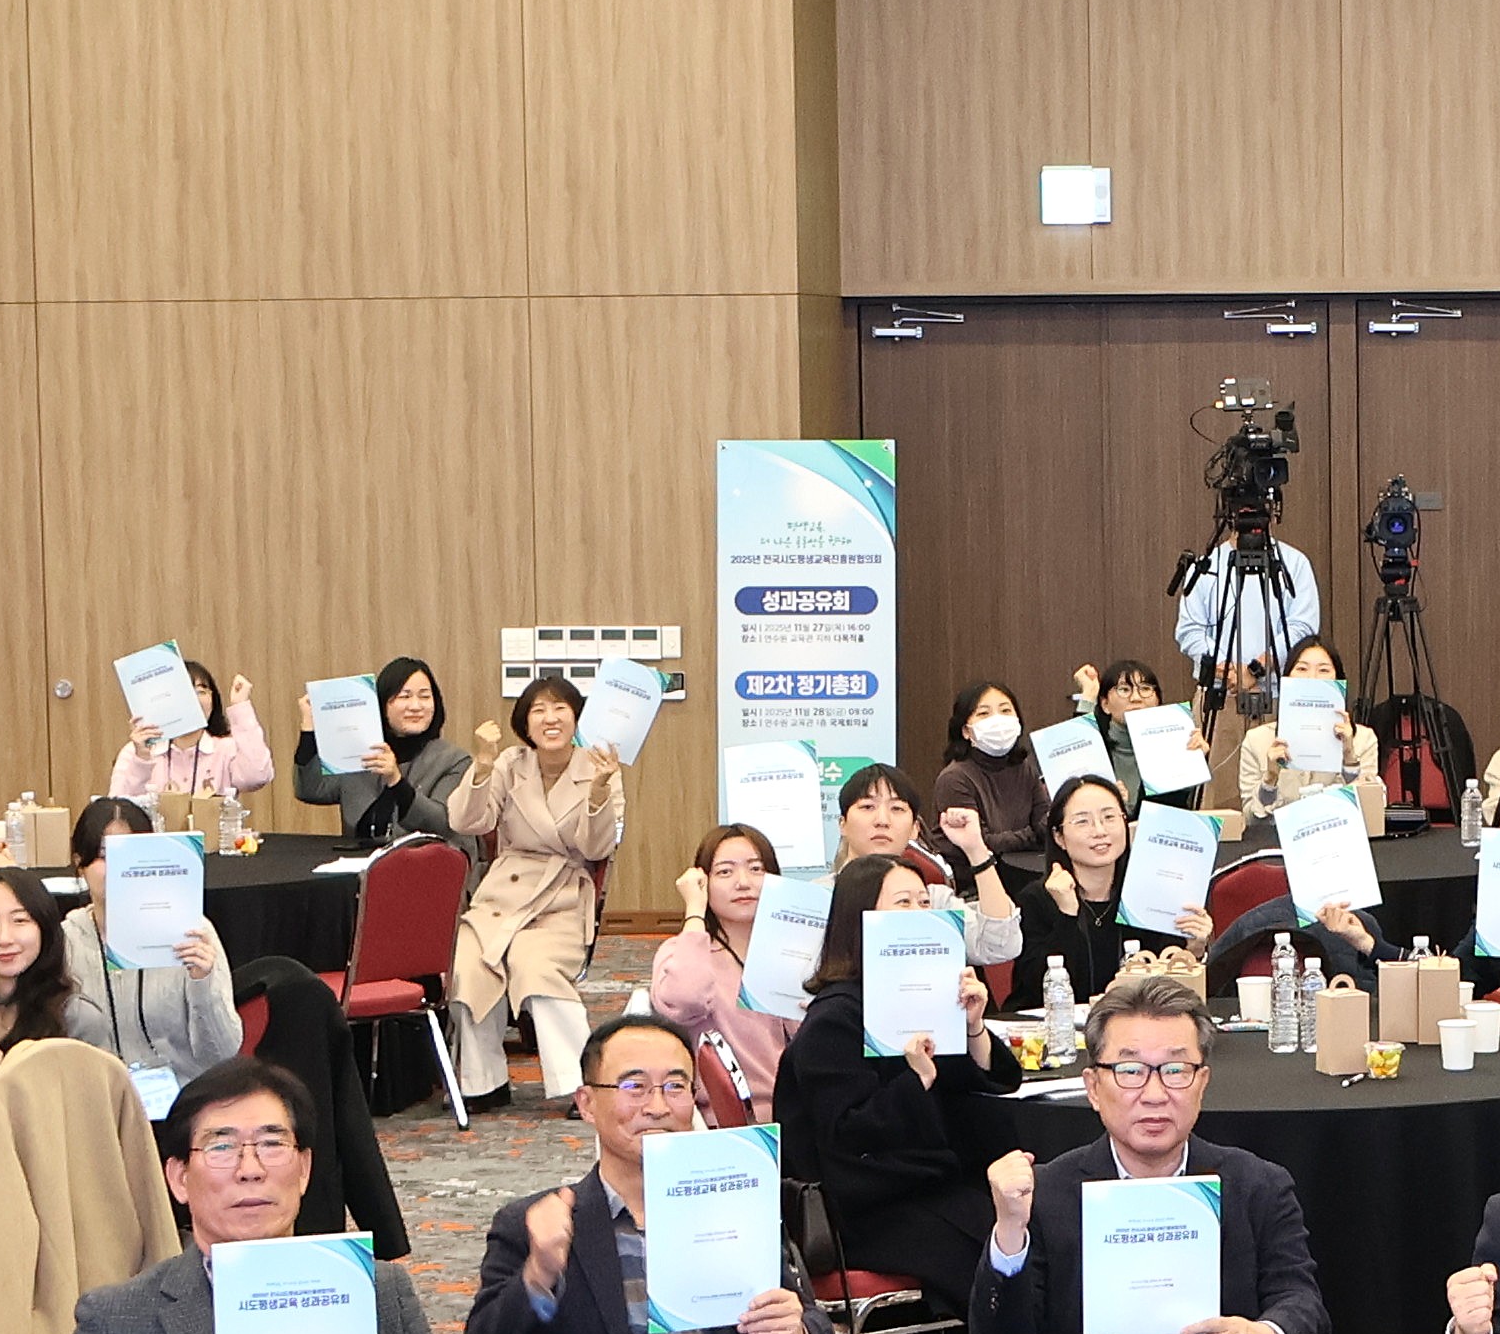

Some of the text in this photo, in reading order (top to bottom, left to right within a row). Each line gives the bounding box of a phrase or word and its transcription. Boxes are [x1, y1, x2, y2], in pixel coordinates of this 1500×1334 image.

[730, 555, 760, 564] 2025년
[761, 590, 850, 612] 성과공유회
[746, 674, 867, 696] 제2차 정기총회
[666, 1178, 759, 1197] 시도평생교육 성과공유회
[1103, 1229, 1198, 1244] 시도평생교육 성과공유회
[238, 1293, 350, 1310] 시도평생교육 성과공유회
